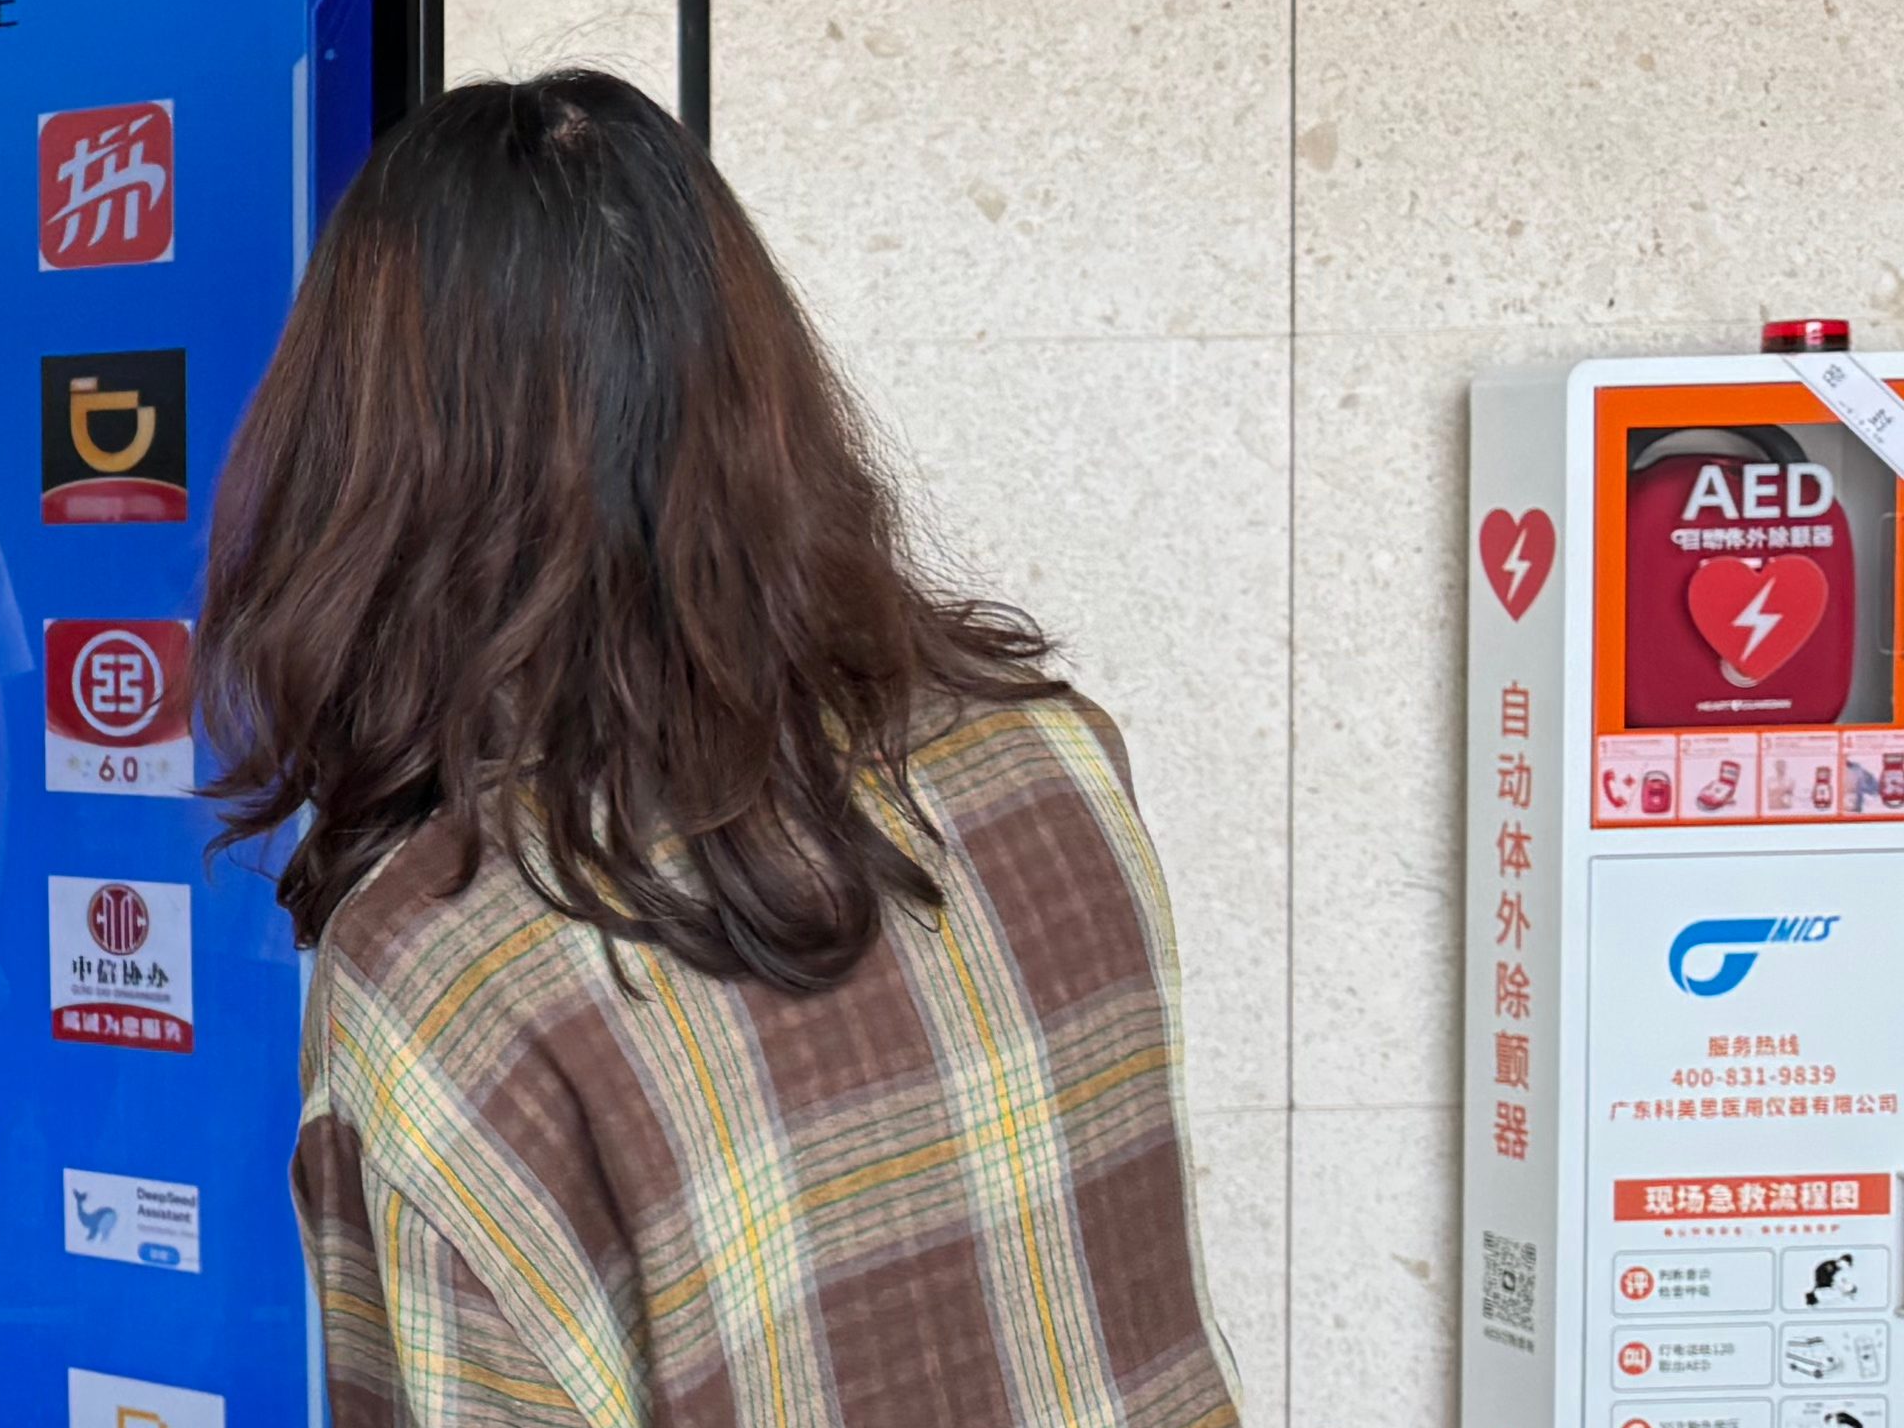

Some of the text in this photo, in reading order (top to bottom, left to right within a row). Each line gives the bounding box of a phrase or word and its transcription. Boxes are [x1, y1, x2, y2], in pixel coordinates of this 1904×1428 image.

[1681, 461, 1835, 521] AED
[99, 755, 139, 783] 6.0
[1494, 680, 1533, 1163] 自动体外除颤器
[1708, 1034, 1800, 1058] 服务热线
[1671, 1065, 1837, 1088] 400-831-9839
[1644, 1181, 1859, 1215] 现场急救流程图
